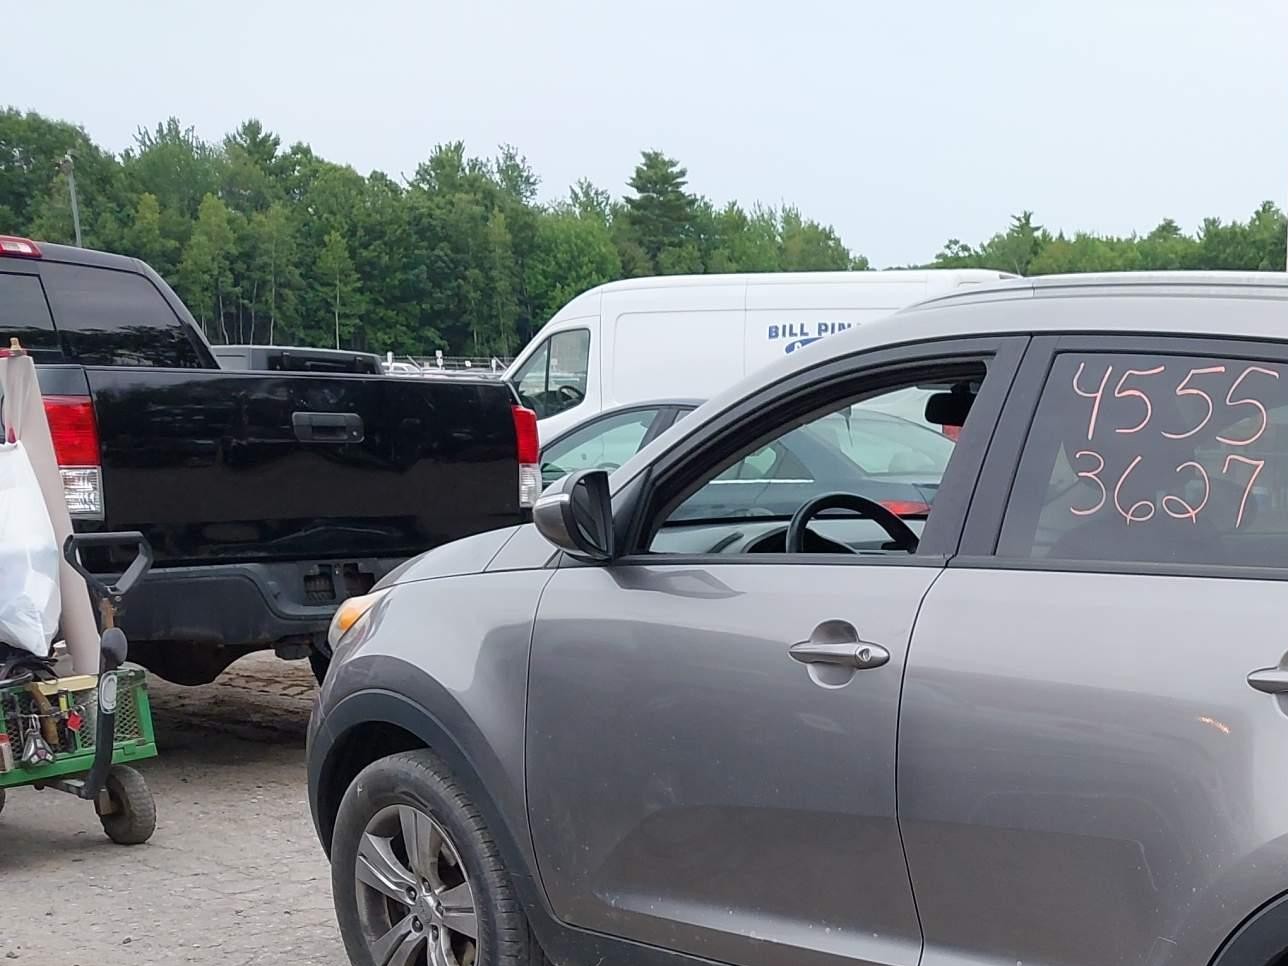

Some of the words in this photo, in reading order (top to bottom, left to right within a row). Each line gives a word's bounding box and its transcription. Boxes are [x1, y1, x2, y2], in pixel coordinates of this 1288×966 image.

[768, 323, 809, 339] BILL
[818, 321, 861, 336] PIN
[1073, 362, 1279, 445] 4555
[1071, 450, 1264, 528] 3627
